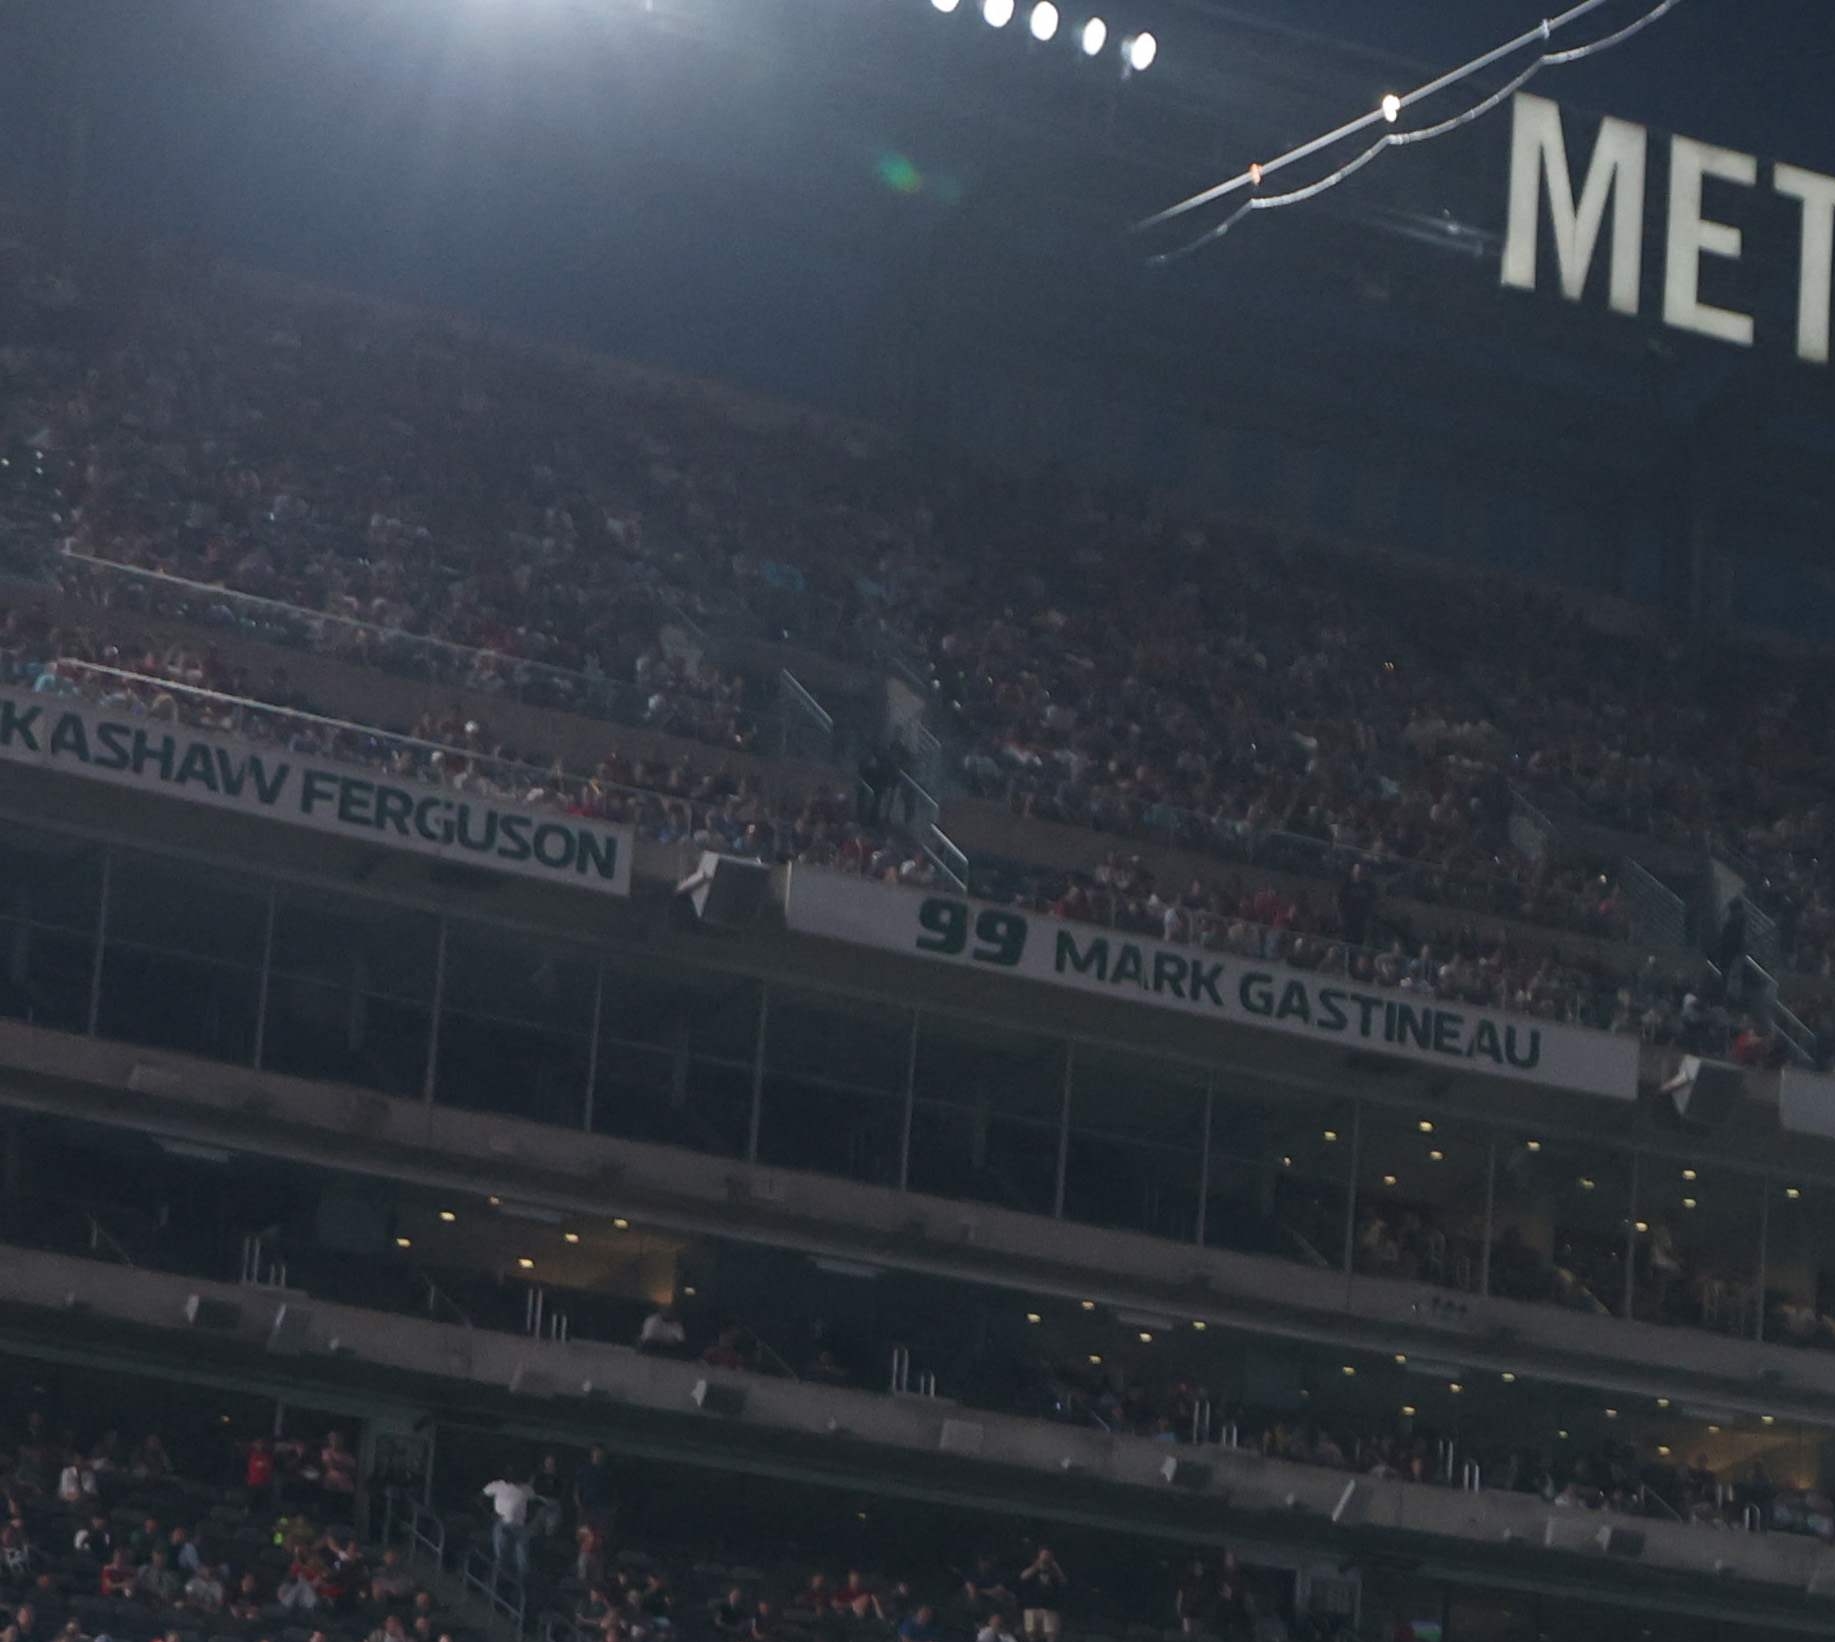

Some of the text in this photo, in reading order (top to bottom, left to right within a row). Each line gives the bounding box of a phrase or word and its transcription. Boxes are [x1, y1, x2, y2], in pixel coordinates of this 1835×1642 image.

[0, 700, 618, 881] KASHAW FERGUSON
[915, 896, 1542, 1071] 99 MARK GASTINEAU
